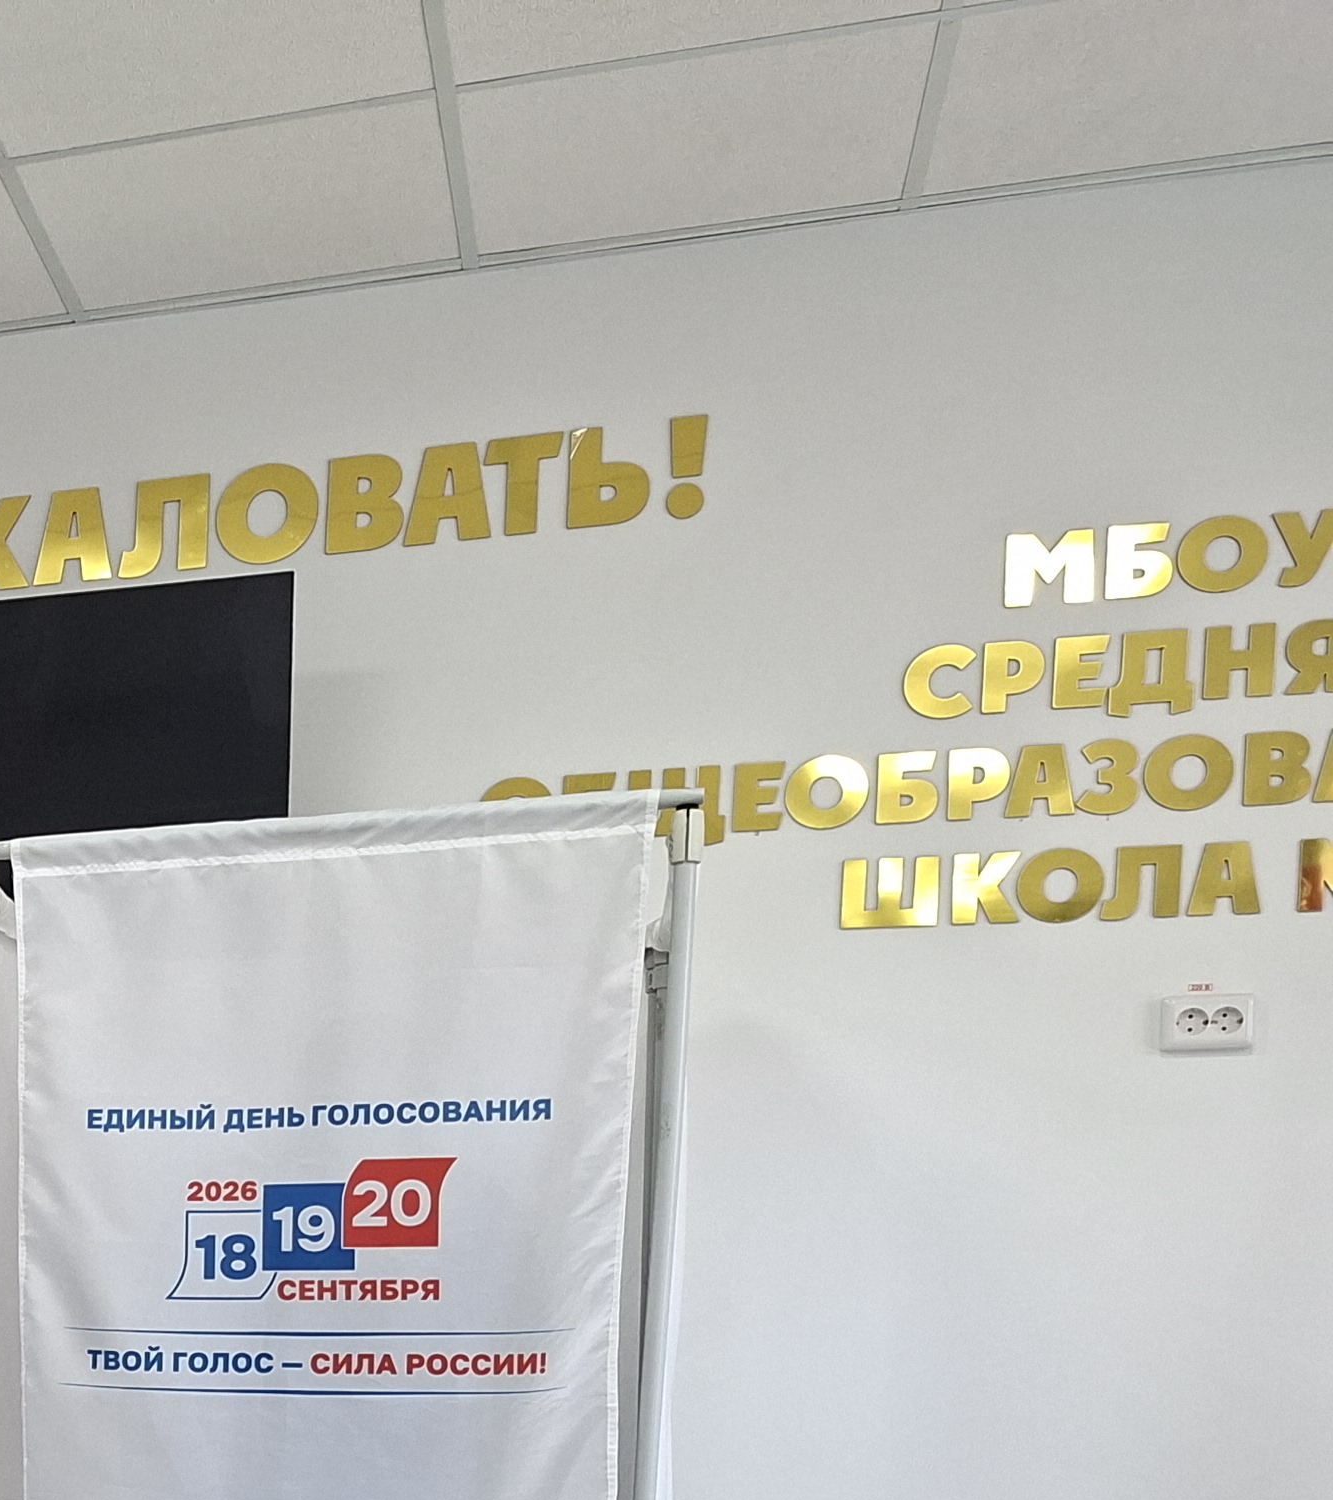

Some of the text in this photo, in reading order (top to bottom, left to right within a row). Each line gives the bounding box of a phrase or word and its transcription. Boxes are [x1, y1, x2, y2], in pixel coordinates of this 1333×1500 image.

[1003, 508, 1333, 608] МБОУ
[840, 841, 1261, 929] ШКОЛА
[86, 1098, 553, 1133] ЕДИНЫЙ ДЕНЬ ГОЛОСОВАНИЯ
[186, 1180, 258, 1202] 2026
[194, 1179, 432, 1281] 18 19 20
[276, 1279, 441, 1301] СЕНТЯБРЯ
[86, 1346, 164, 1374] ТВОЙ
[172, 1351, 275, 1375] ГОЛОС
[309, 1352, 397, 1376] СИЛА
[406, 1353, 547, 1376] РОССИИ!
